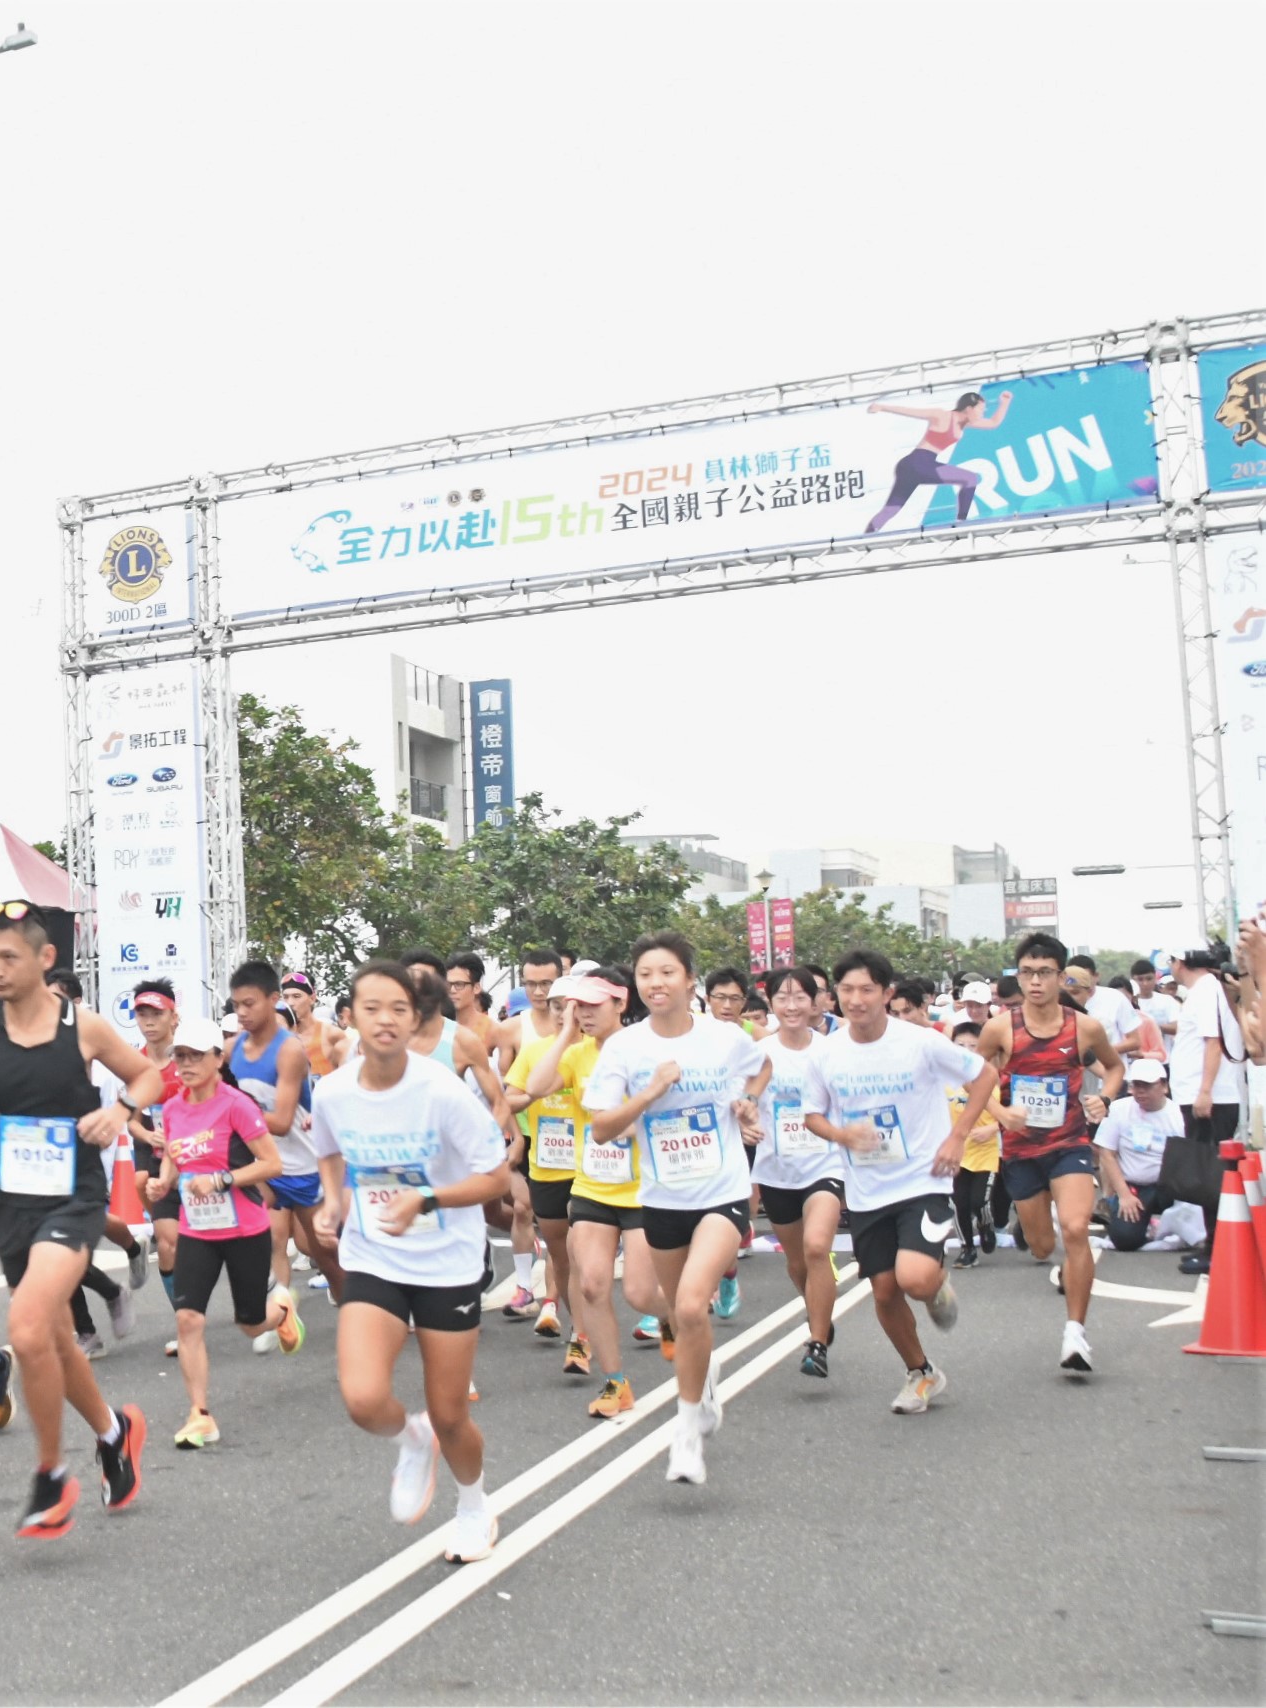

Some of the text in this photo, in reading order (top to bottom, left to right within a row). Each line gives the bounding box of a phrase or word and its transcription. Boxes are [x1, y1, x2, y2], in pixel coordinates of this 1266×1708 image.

[598, 443, 832, 499] 2024 員林獅子盃
[954, 414, 1113, 519] RUN
[610, 469, 866, 532] 全國親子公益路跑
[113, 529, 155, 548] LIONS
[336, 494, 604, 565] 全力以赴 15th
[127, 549, 147, 577] L
[106, 607, 141, 624] 300D
[146, 784, 184, 793] SUBARU
[1021, 1095, 1060, 1107] 10294
[544, 1137, 574, 1148] 2004
[660, 1133, 712, 1152] 20106
[13, 1147, 65, 1163] 10104
[590, 1147, 625, 1159] 20049
[187, 1193, 227, 1206] 20033
